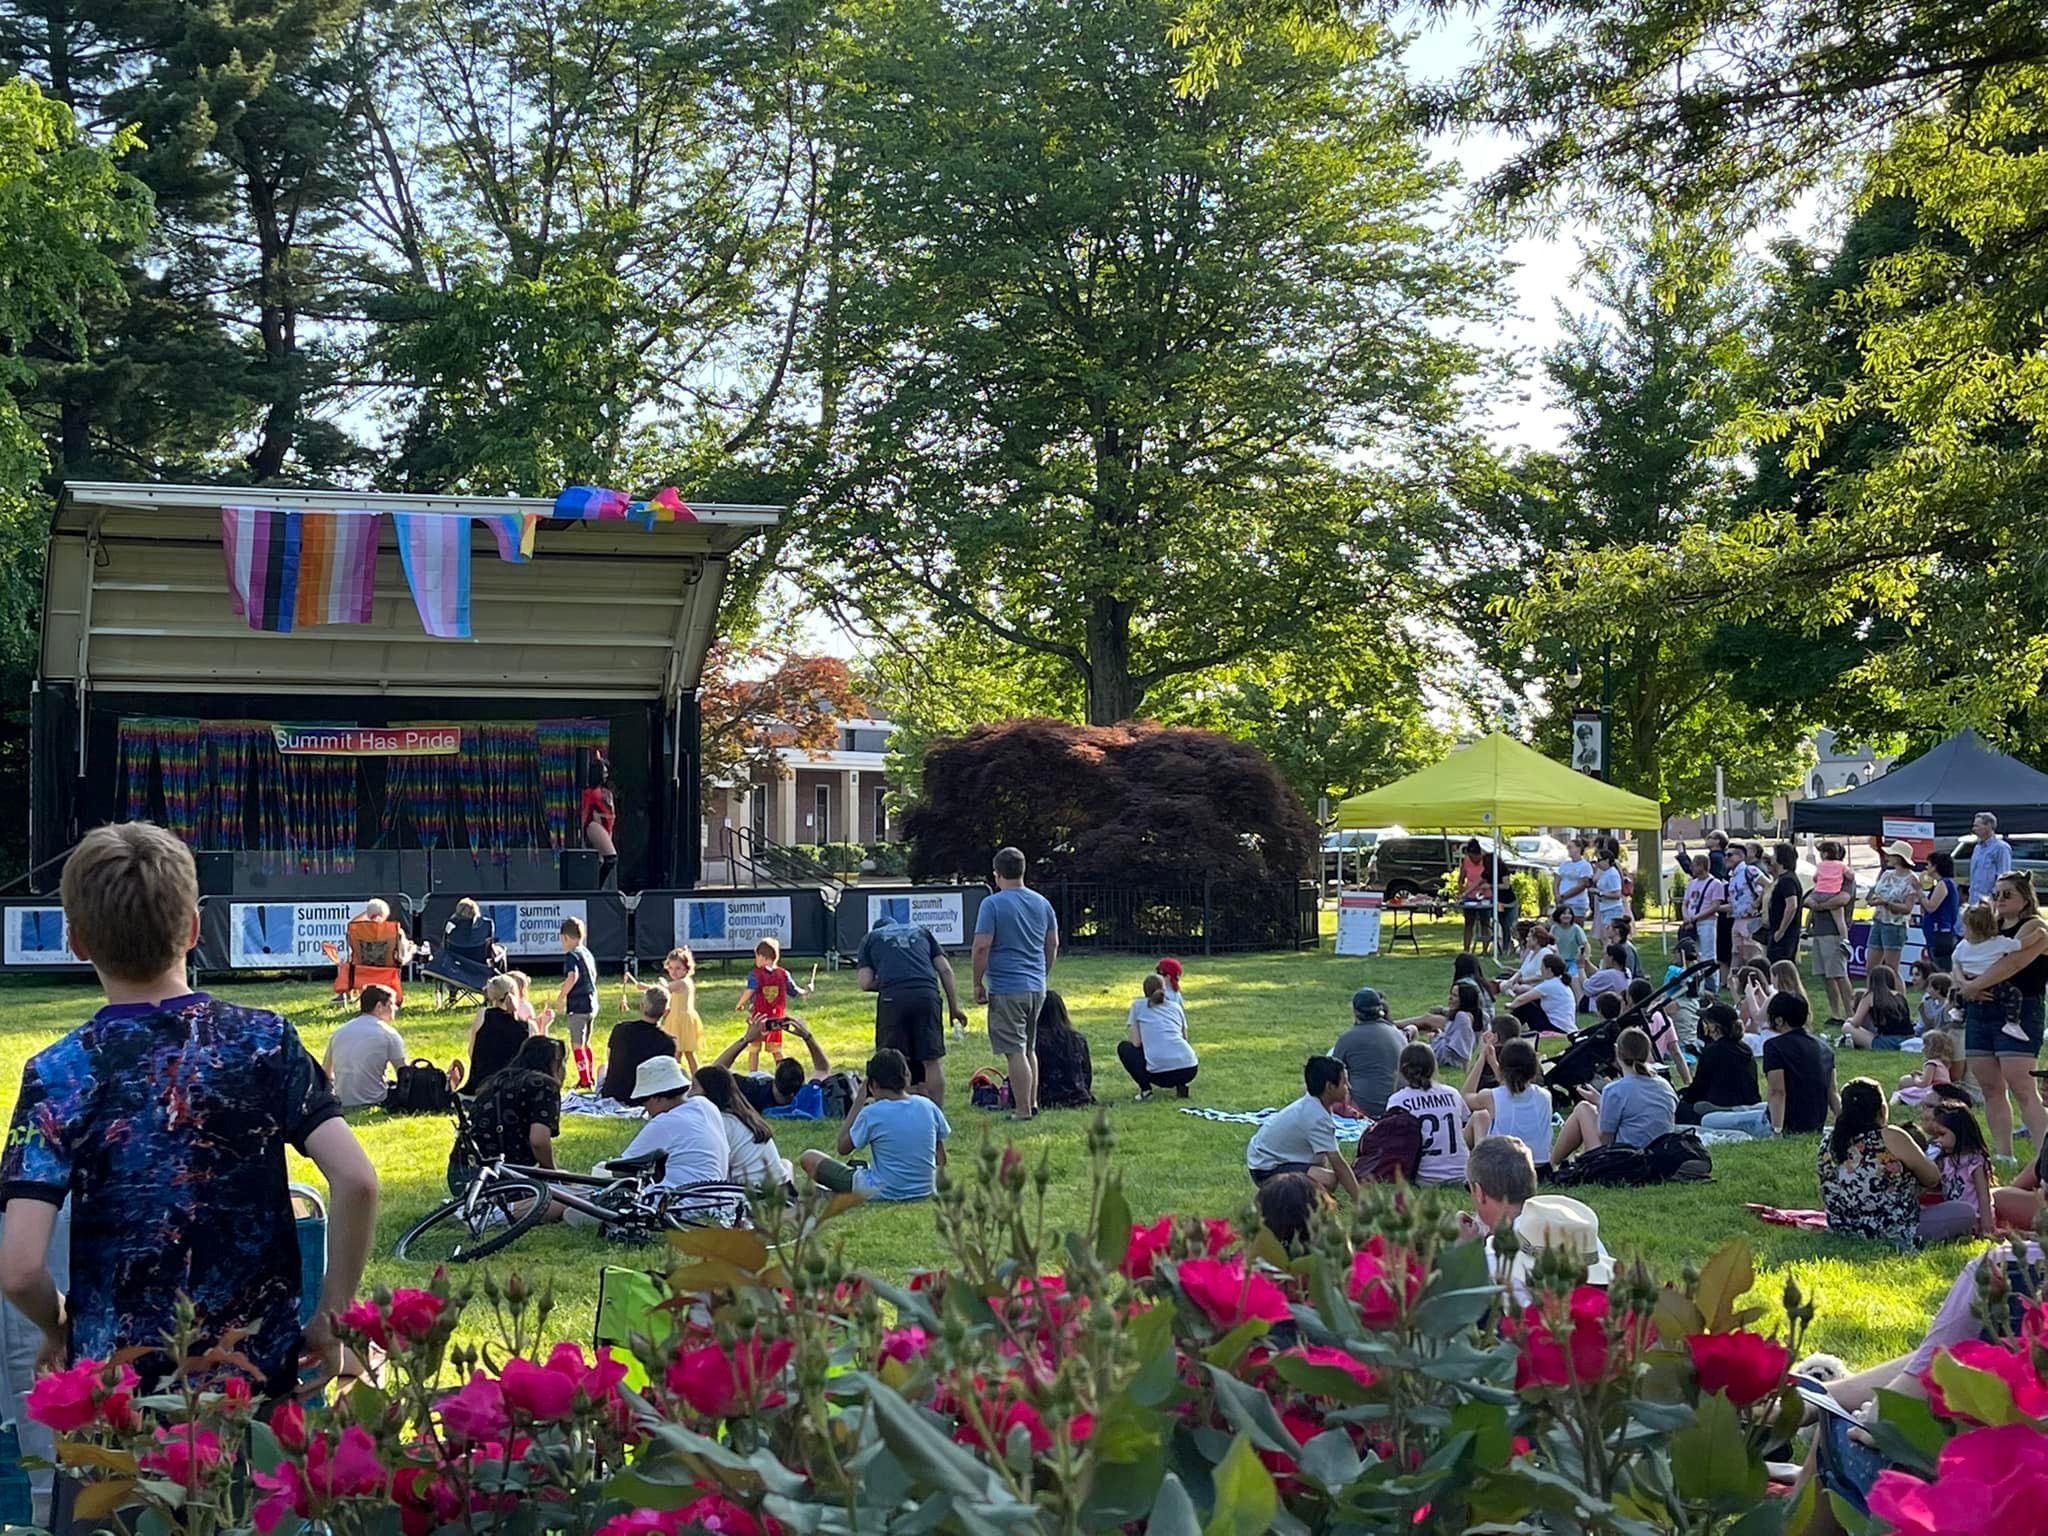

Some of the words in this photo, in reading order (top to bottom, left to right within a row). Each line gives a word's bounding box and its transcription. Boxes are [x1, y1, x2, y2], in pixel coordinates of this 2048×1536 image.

[276, 730, 353, 749] Summit
[359, 733, 399, 750] Has
[405, 732, 456, 750] Pride
[728, 901, 766, 914] summit
[912, 897, 943, 909] summit
[298, 904, 350, 920] summit
[520, 904, 560, 917] summit
[912, 909, 958, 923] community
[520, 919, 561, 930] commu
[728, 913, 785, 927] community
[520, 932, 560, 945] progra
[728, 928, 778, 941] programs
[1402, 1093, 1456, 1111] SUMMIT
[1421, 1112, 1457, 1157] 21
